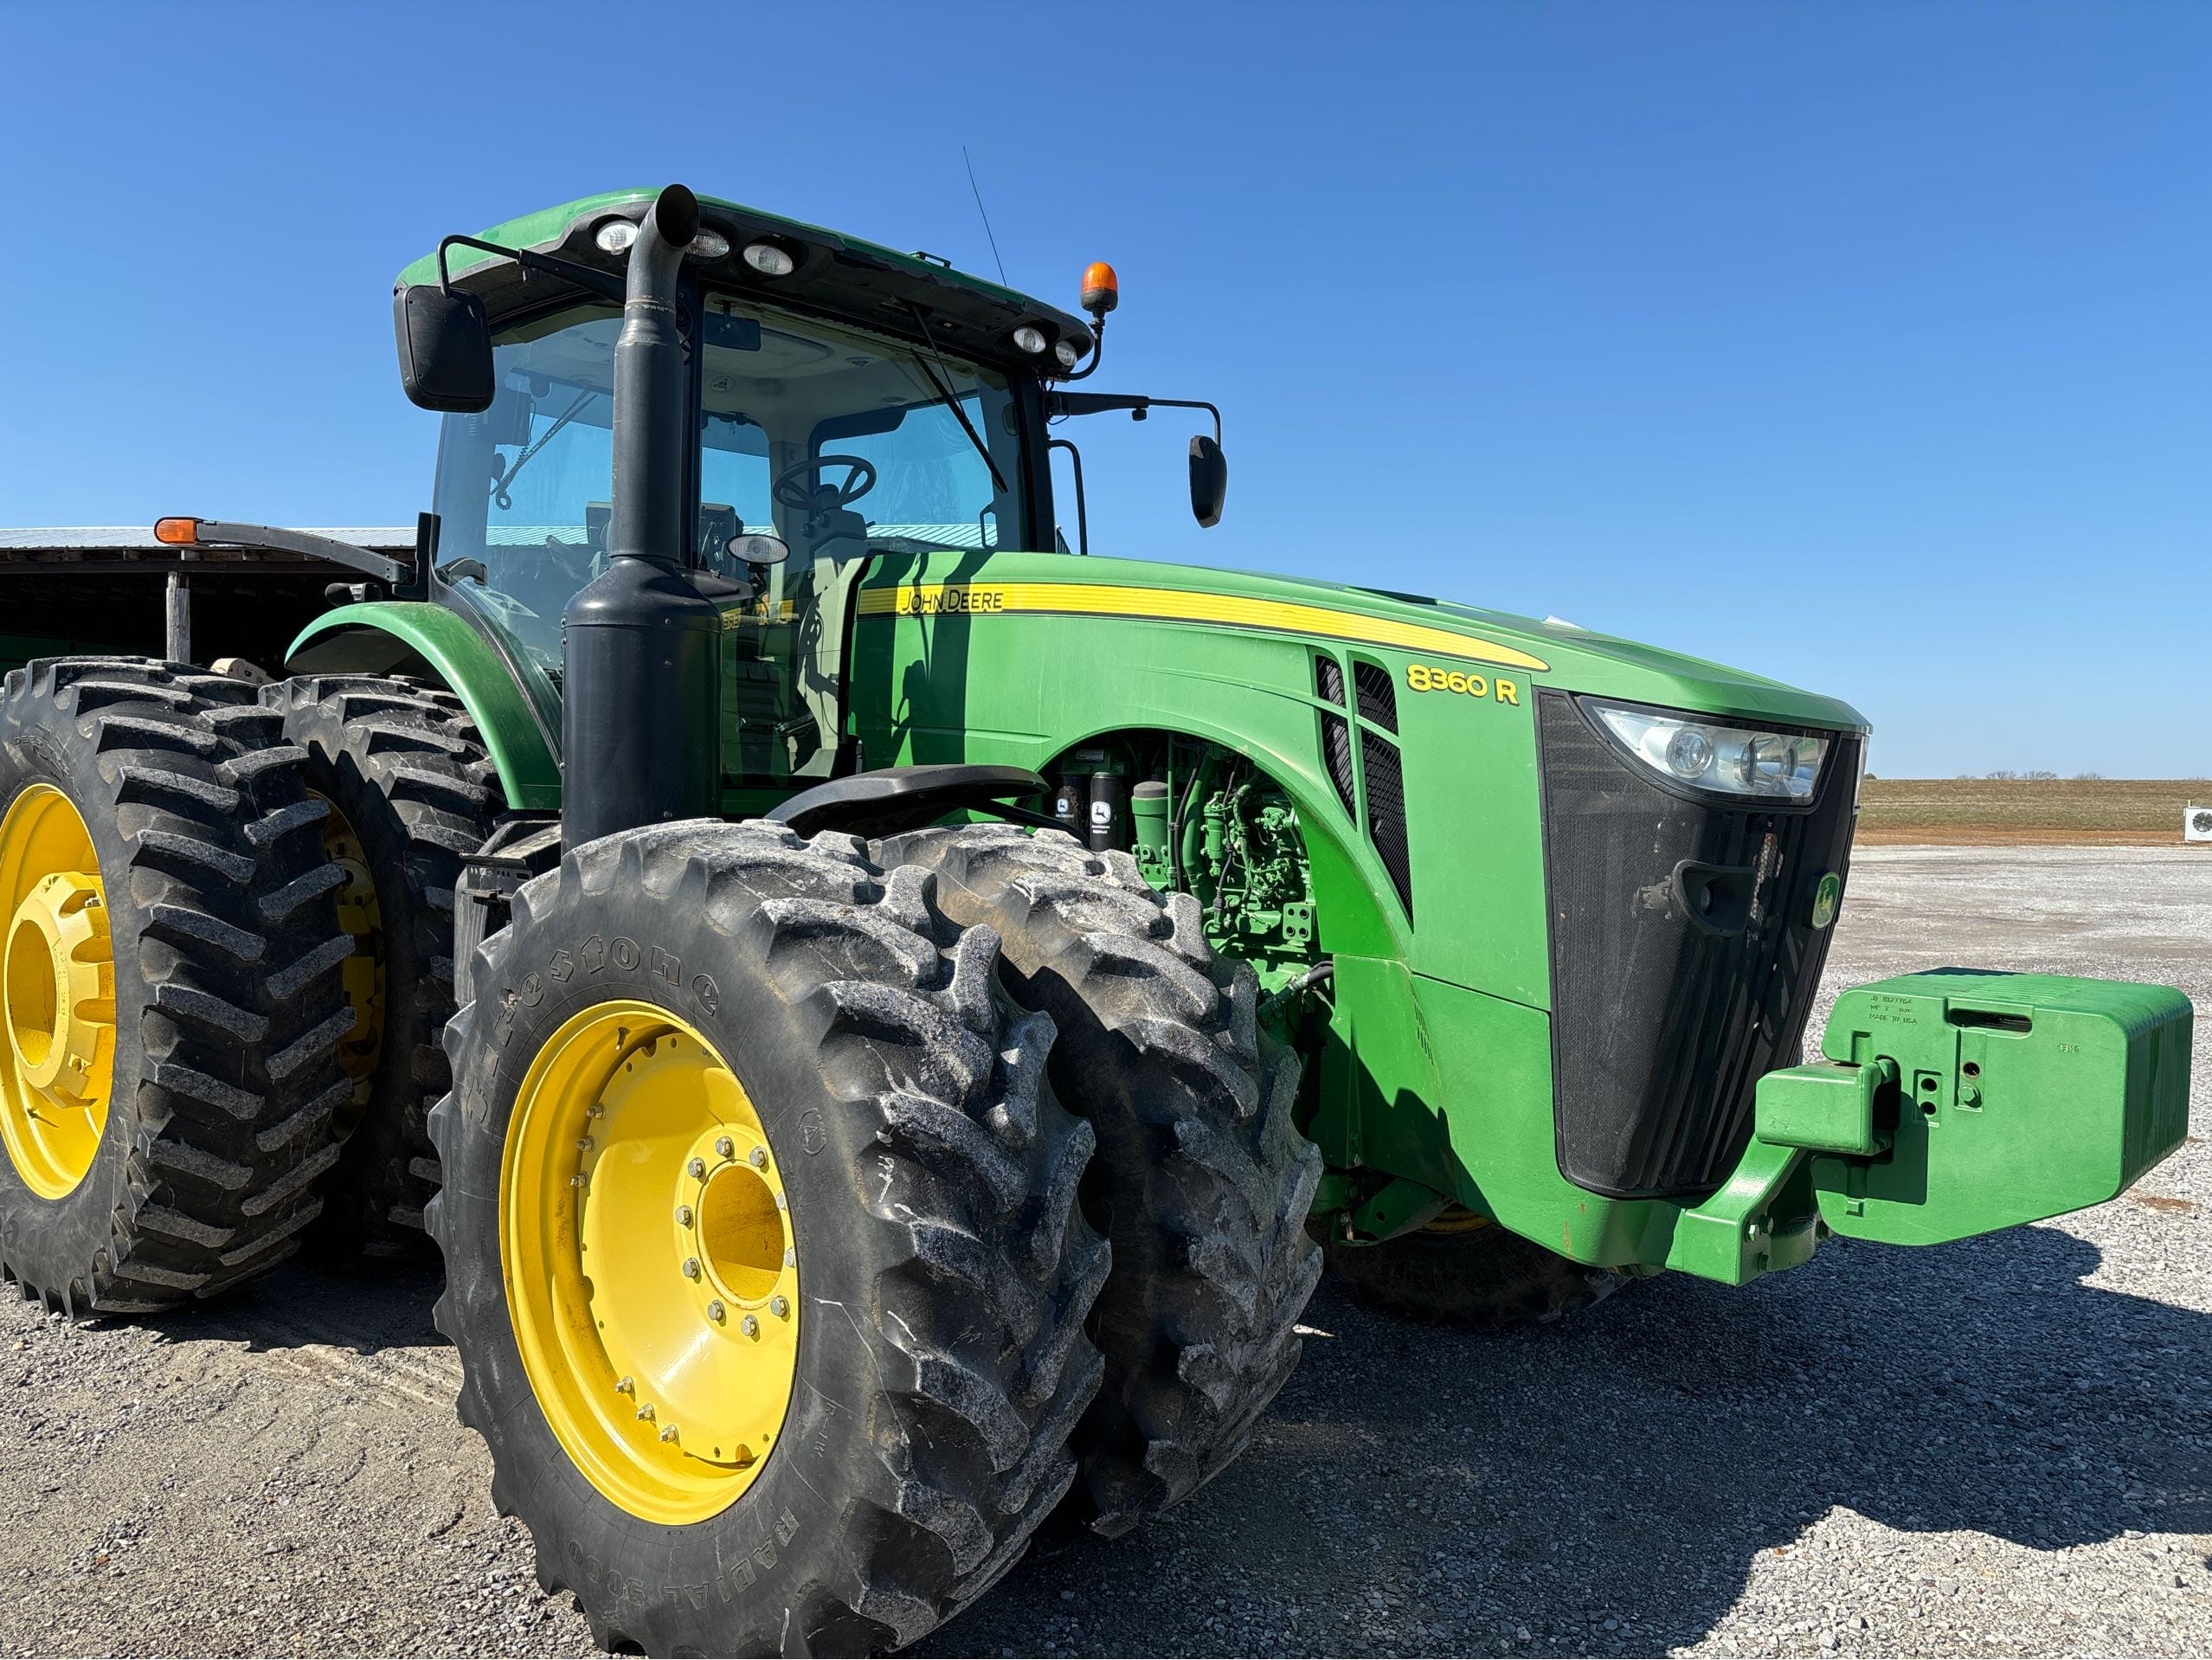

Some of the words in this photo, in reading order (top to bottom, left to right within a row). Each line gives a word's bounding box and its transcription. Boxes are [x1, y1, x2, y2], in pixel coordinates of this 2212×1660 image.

[901, 590, 944, 611] JOHN
[948, 589, 1004, 610] DEERE
[1406, 664, 1489, 698] 8360
[1494, 679, 1521, 706] R
[466, 934, 720, 1123] Firestone
[664, 1506, 800, 1612] RADIAL
